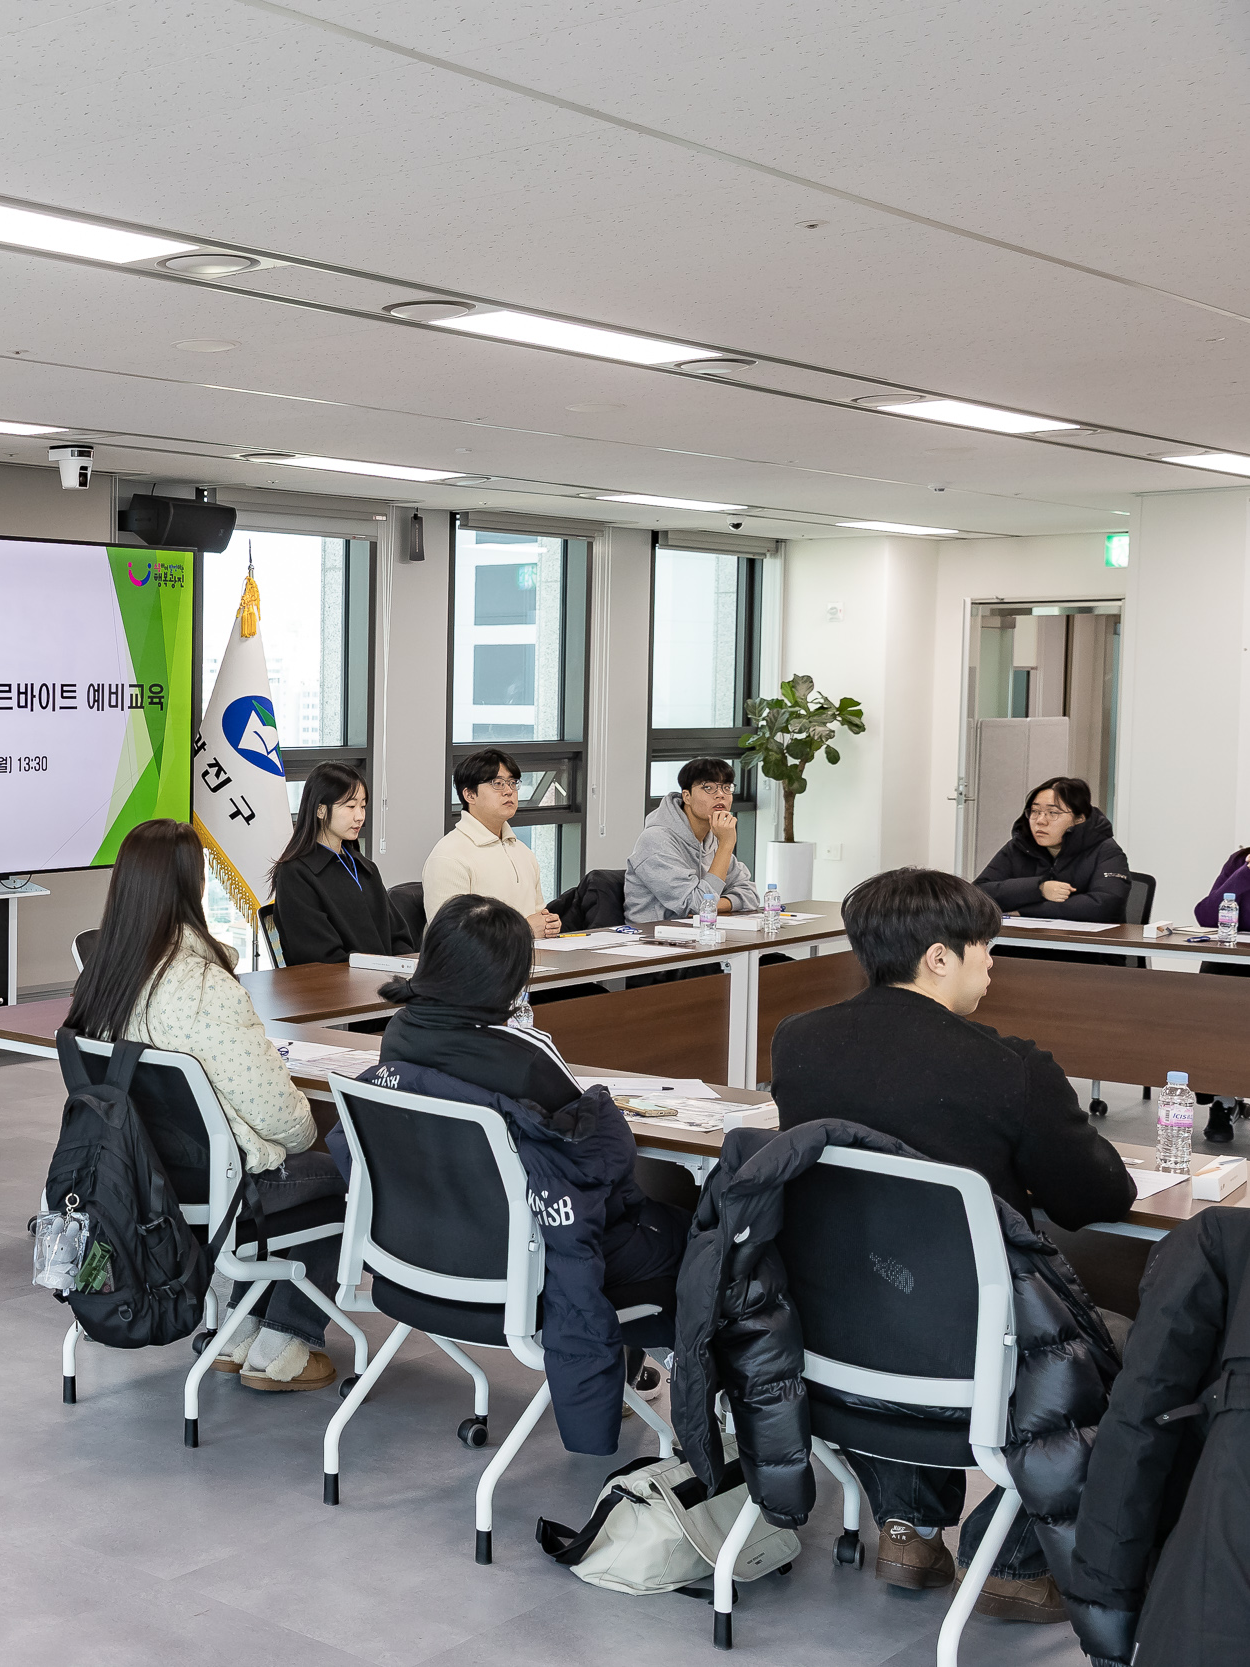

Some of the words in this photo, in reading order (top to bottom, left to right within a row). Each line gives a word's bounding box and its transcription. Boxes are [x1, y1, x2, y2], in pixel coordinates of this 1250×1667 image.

[154, 572, 185, 588] 행복광진
[87, 683, 165, 711] 예비교육
[17, 756, 48, 772] 13:30
